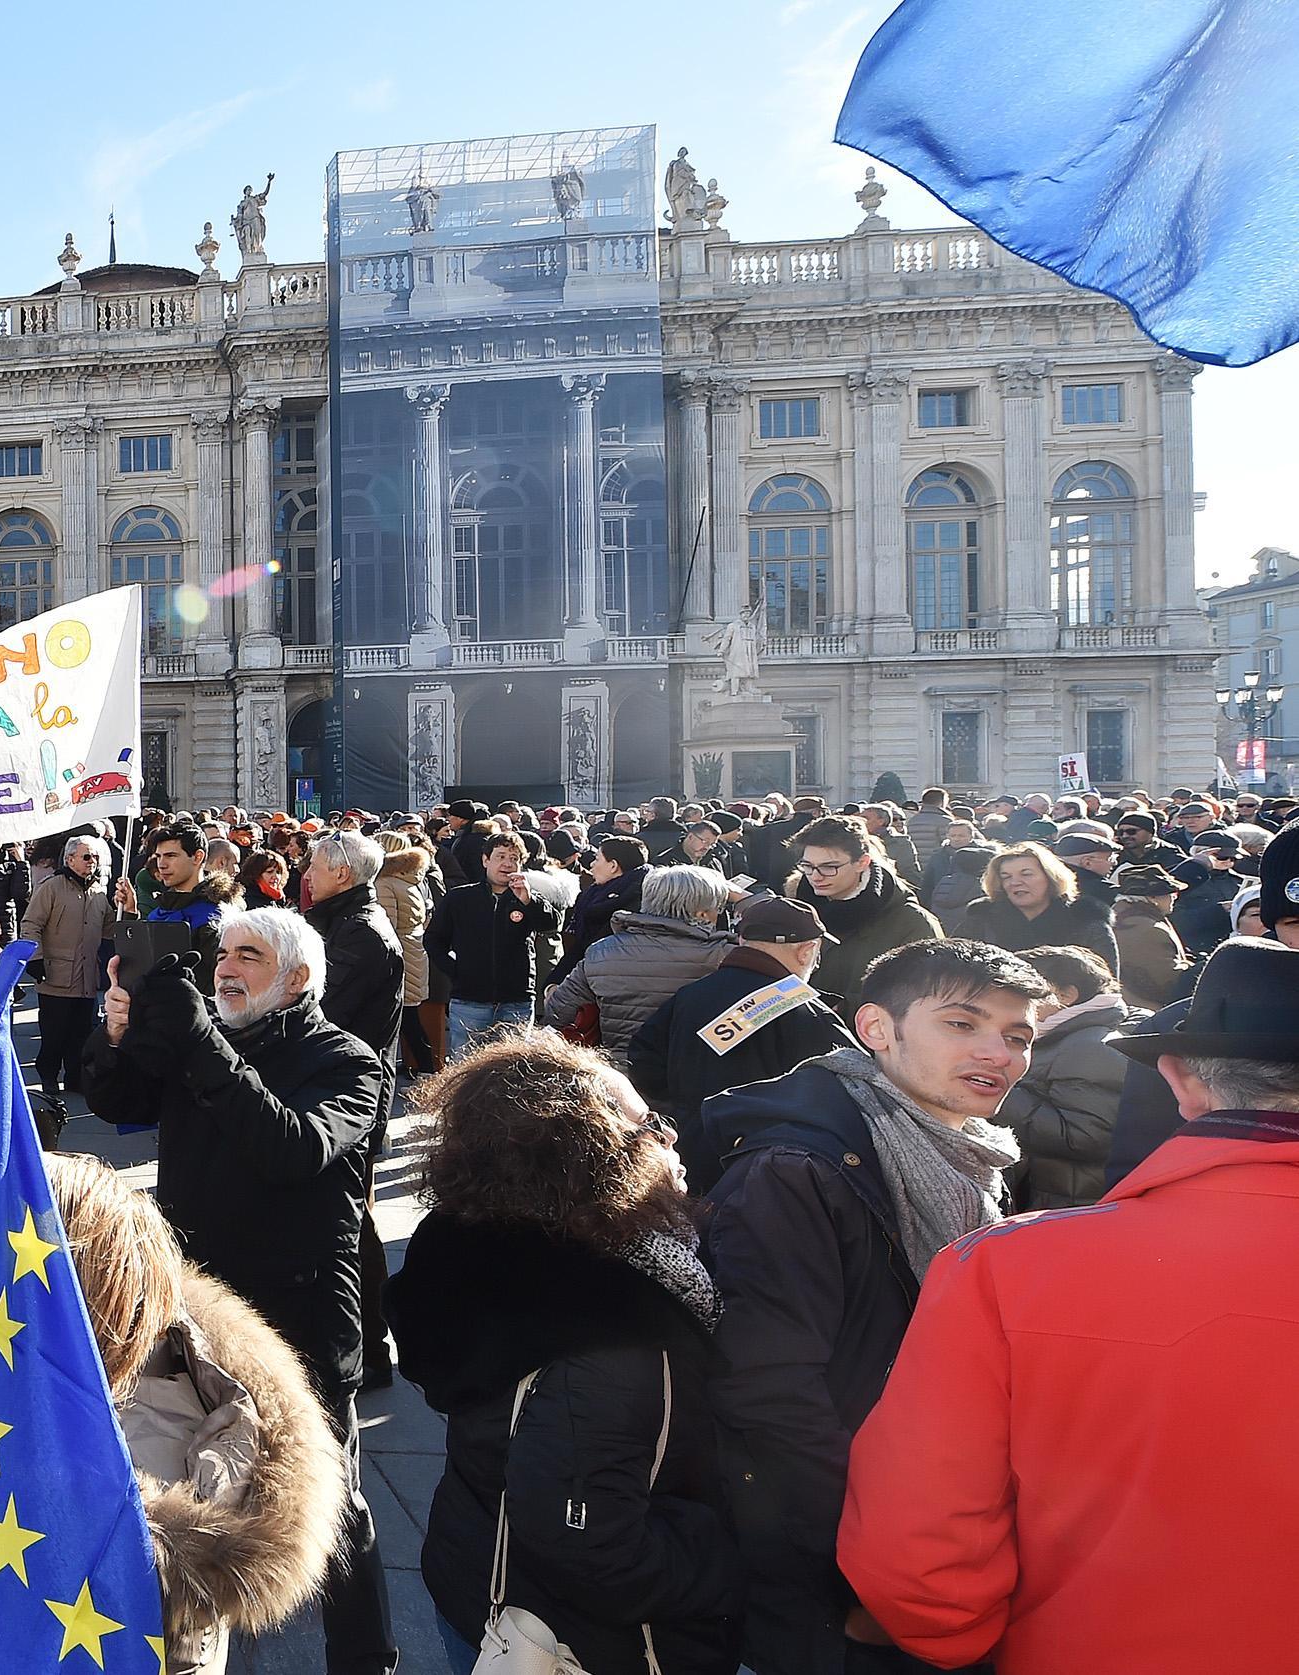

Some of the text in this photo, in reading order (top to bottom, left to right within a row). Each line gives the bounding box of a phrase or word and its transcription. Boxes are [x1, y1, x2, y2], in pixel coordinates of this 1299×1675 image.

[31, 681, 78, 730] la
[1061, 756, 1078, 778] SÌ
[76, 777, 103, 795] TAV
[1061, 777, 1083, 791] AV
[736, 998, 757, 1013] TAV
